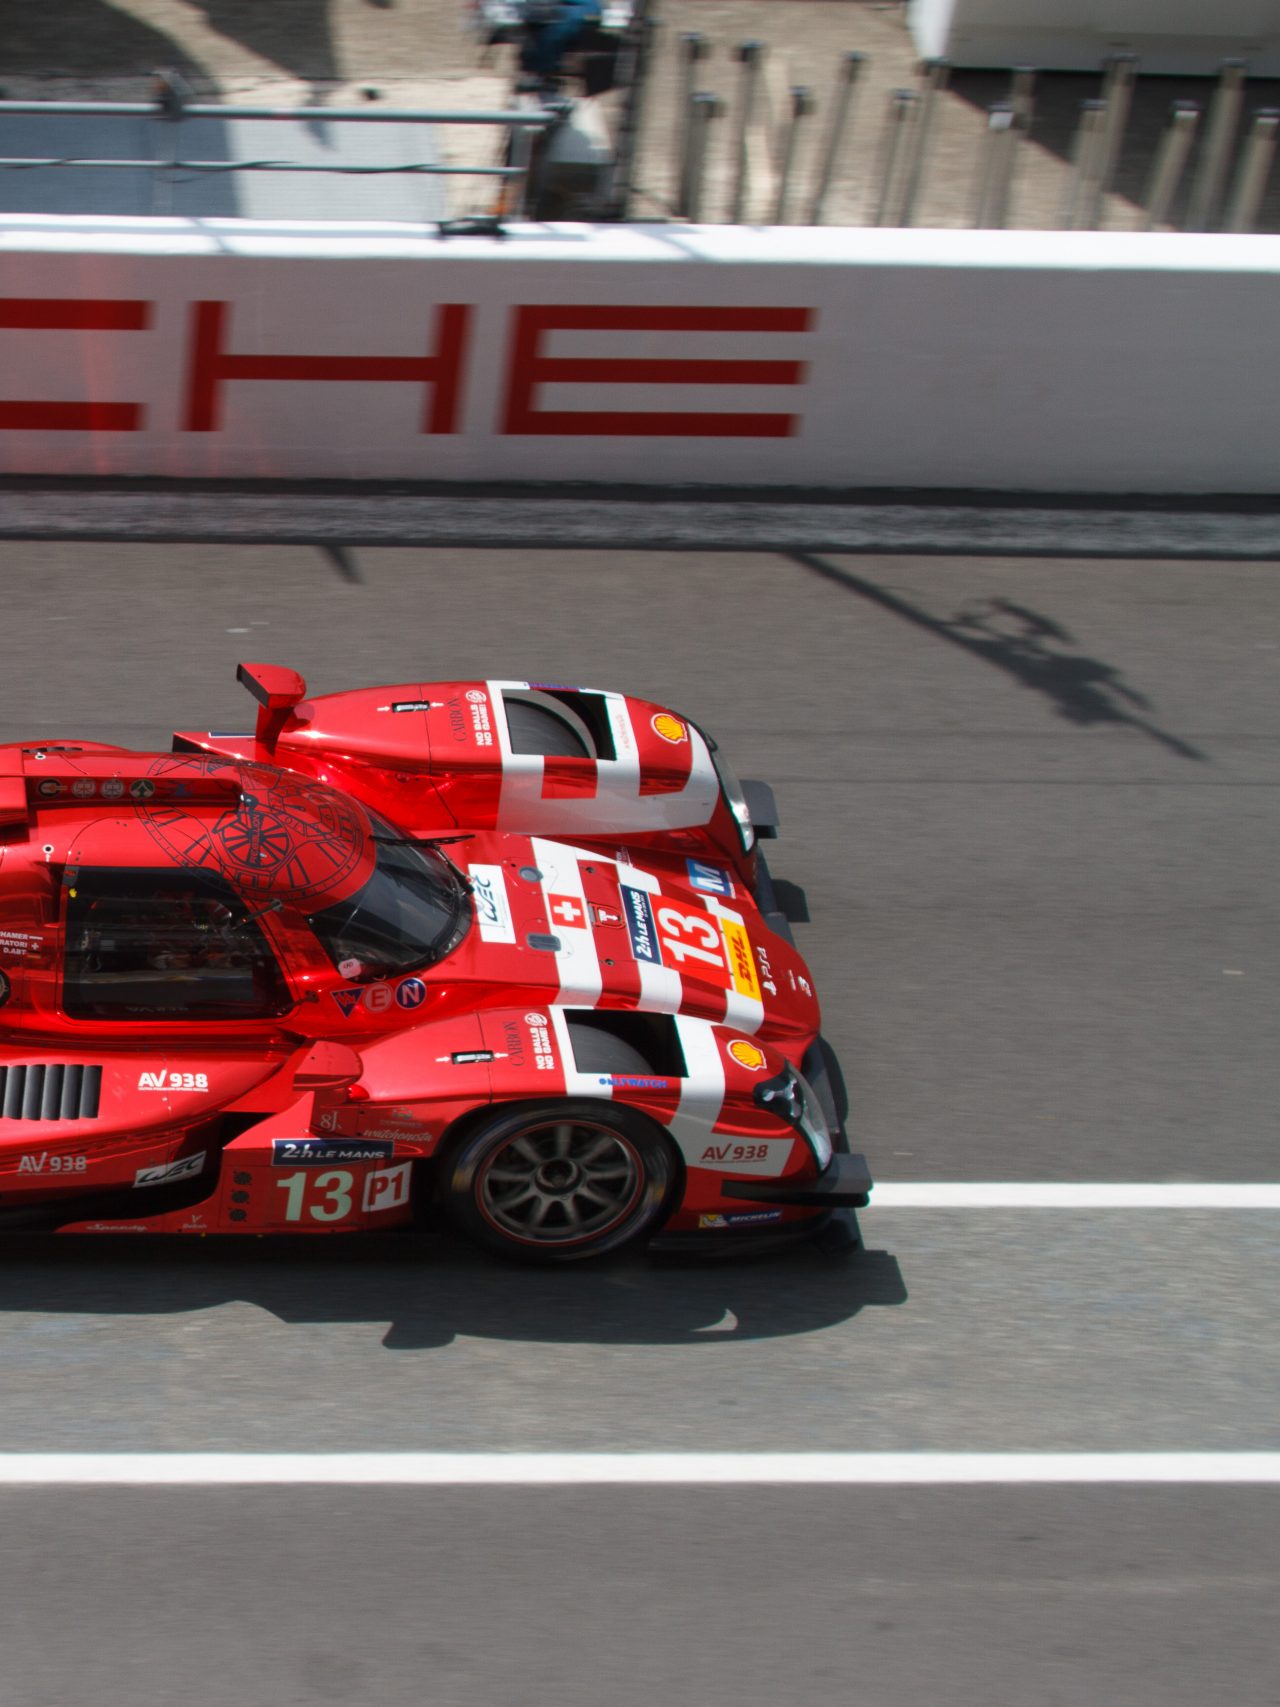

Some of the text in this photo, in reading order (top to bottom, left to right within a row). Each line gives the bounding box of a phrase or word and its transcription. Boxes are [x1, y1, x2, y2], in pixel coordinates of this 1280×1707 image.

[476, 732, 485, 746] NO
[484, 731, 492, 746] NO
[631, 890, 646, 925] MANS
[658, 907, 724, 969] 13
[730, 935, 752, 983] DHL
[757, 947, 770, 980] PS4
[402, 983, 421, 1005] N
[534, 1028, 546, 1070] NO BALLS
[545, 1055, 555, 1070] NO
[138, 1070, 208, 1087] AV 938
[18, 1152, 87, 1172] AV 938
[315, 1151, 336, 1159] LE
[338, 1151, 385, 1159] MANS
[701, 1143, 768, 1161] AV 938
[276, 1170, 354, 1222] 13
[368, 1172, 405, 1206] P1
[729, 1211, 781, 1223] MICHELIN
